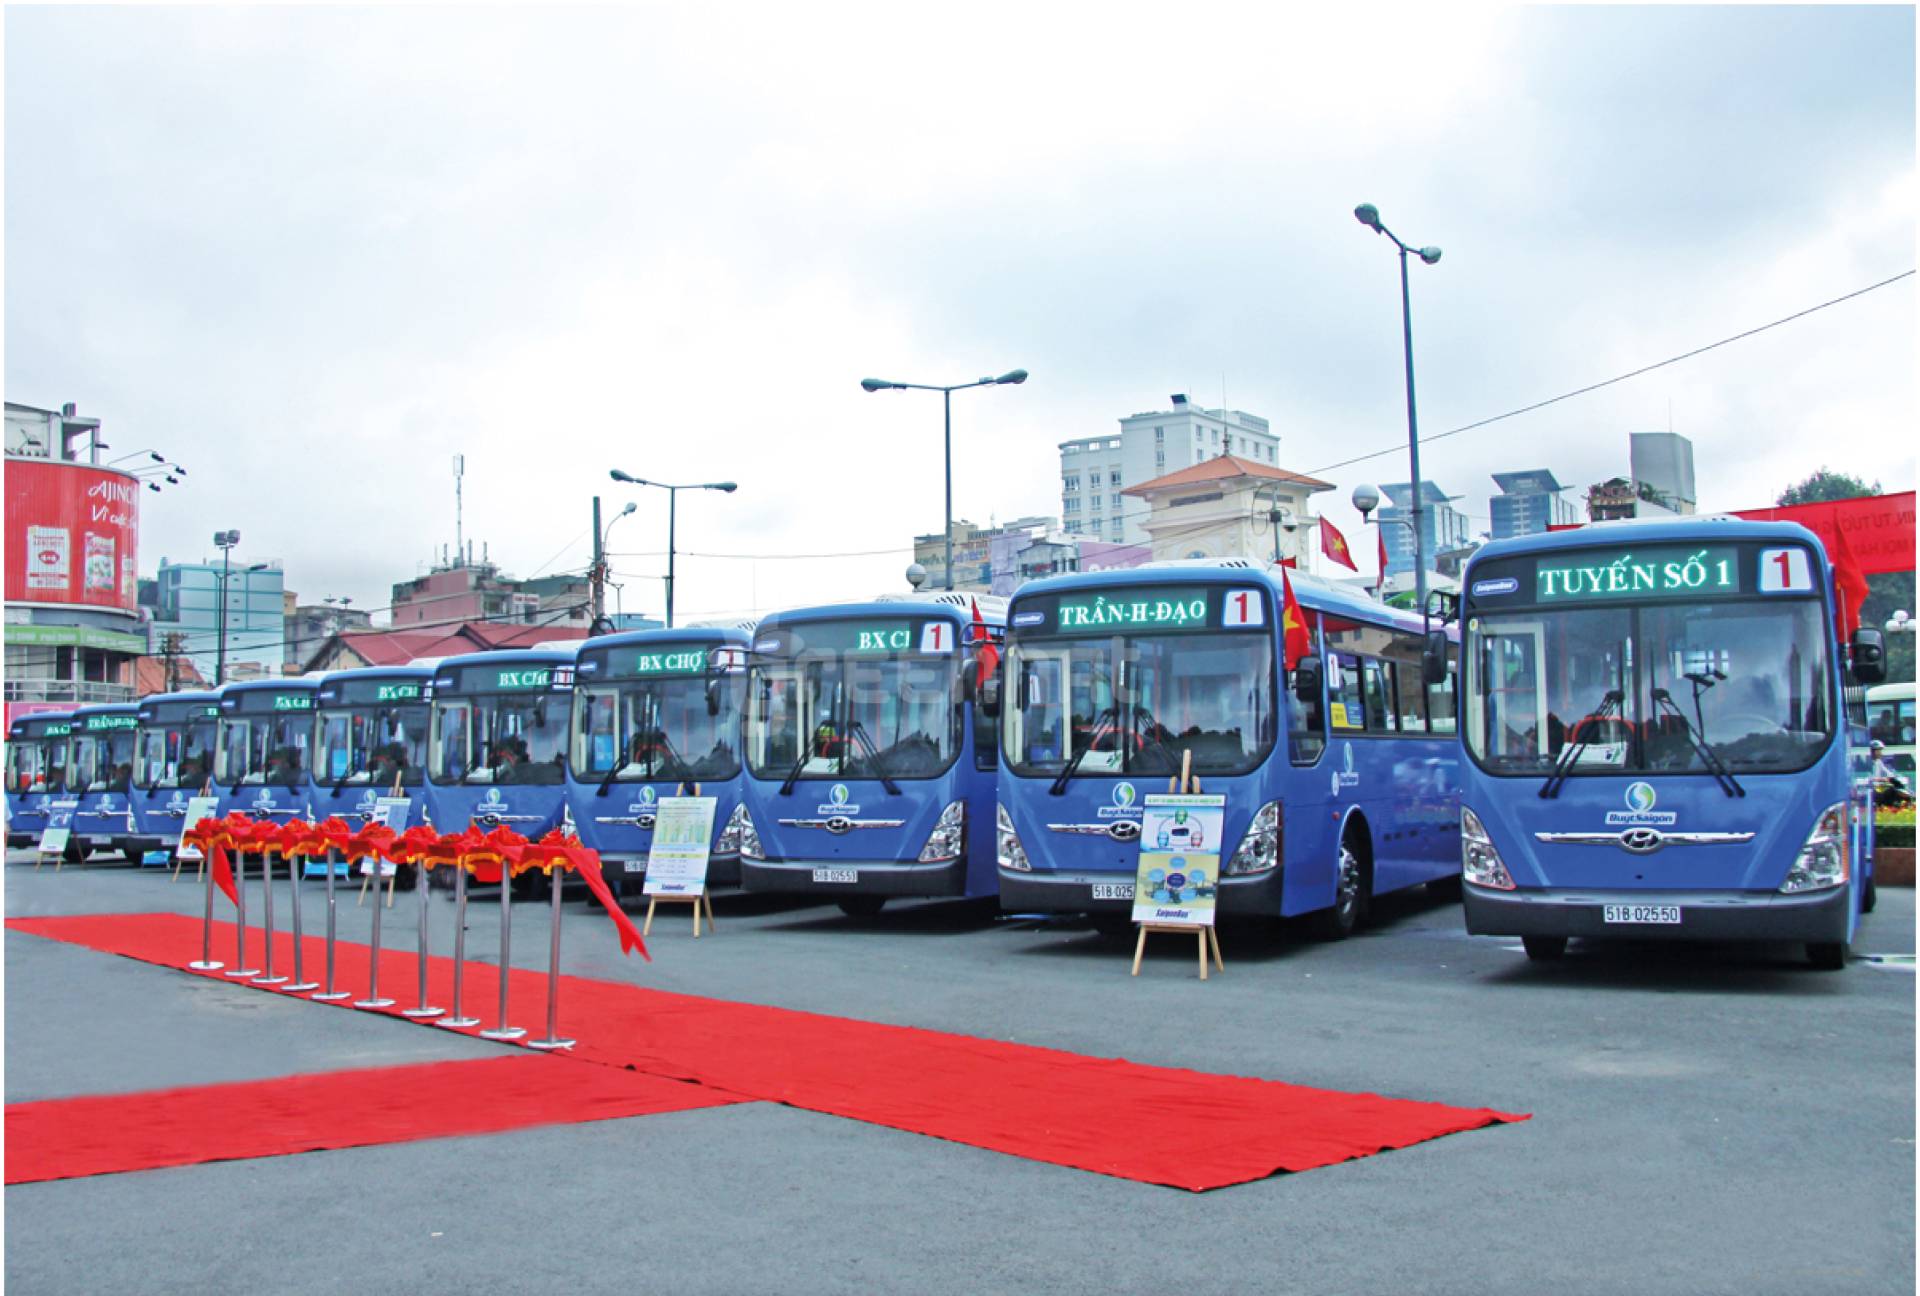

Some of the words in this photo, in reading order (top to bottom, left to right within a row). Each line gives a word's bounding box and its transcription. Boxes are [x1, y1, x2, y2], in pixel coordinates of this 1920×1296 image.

[1539, 554, 1656, 595] TUYẾN
[1664, 550, 1707, 588] SỐ
[1717, 560, 1731, 585] 1
[1773, 551, 1791, 588] 1
[1060, 596, 1206, 625] TRẦN-H-ĐẠO
[1234, 592, 1248, 623] 1
[859, 632, 886, 649] BX
[930, 624, 941, 650] 1
[639, 655, 662, 671] BX
[665, 651, 703, 672] CHỢ
[499, 672, 520, 686] BX
[378, 687, 398, 700] BX
